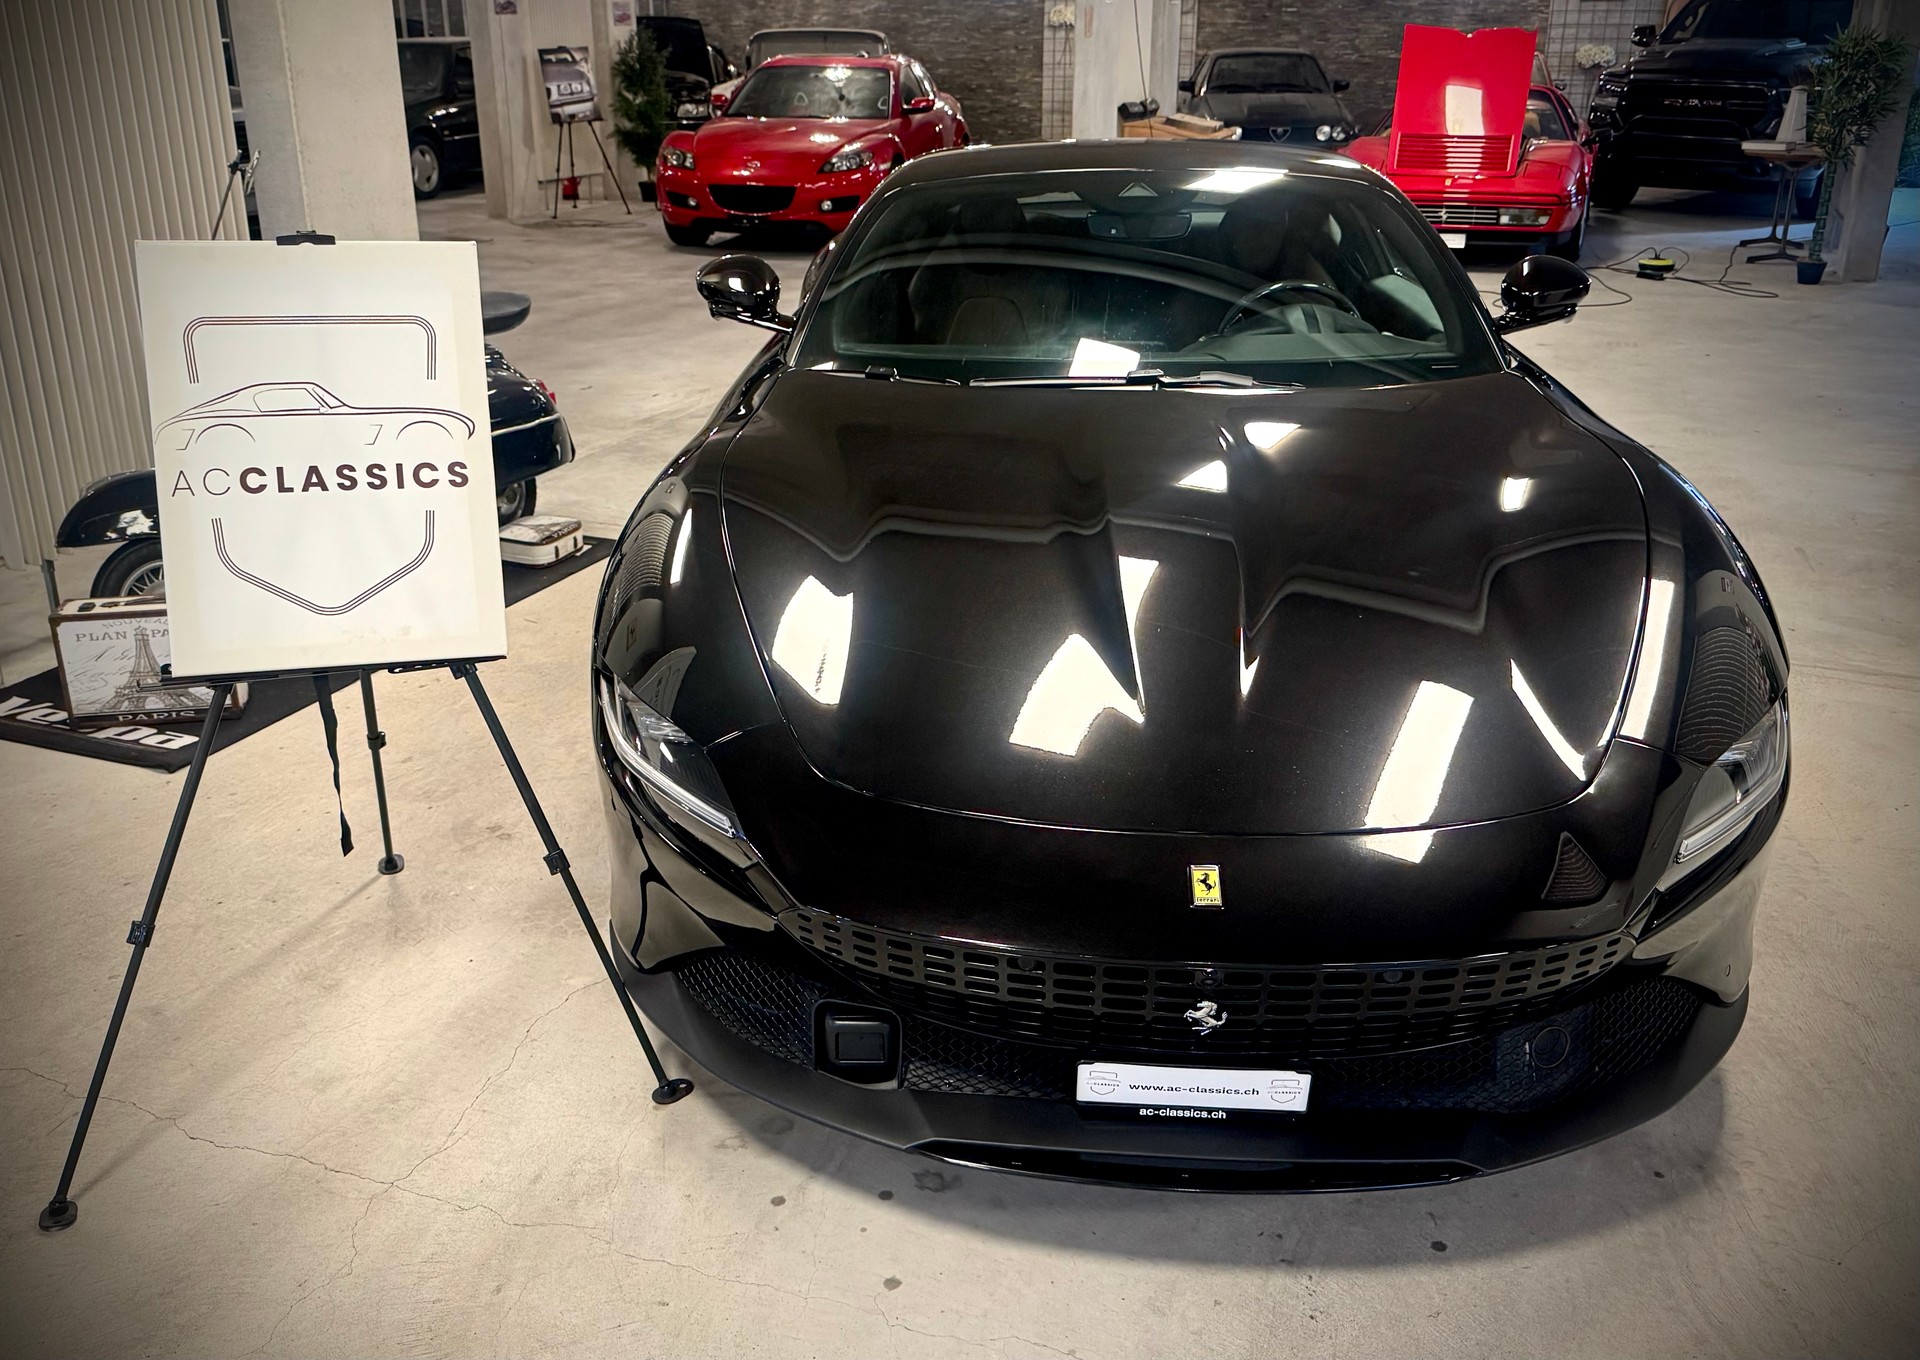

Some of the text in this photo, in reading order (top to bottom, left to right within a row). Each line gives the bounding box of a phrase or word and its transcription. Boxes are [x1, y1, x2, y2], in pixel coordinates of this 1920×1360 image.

[75, 630, 128, 642] PLAN
[118, 710, 195, 722] PARIS
[0, 696, 200, 750] Vepa
[1128, 1083, 1260, 1096] www.ac-classics.ch
[1139, 1107, 1227, 1120] ac-classics.ch
